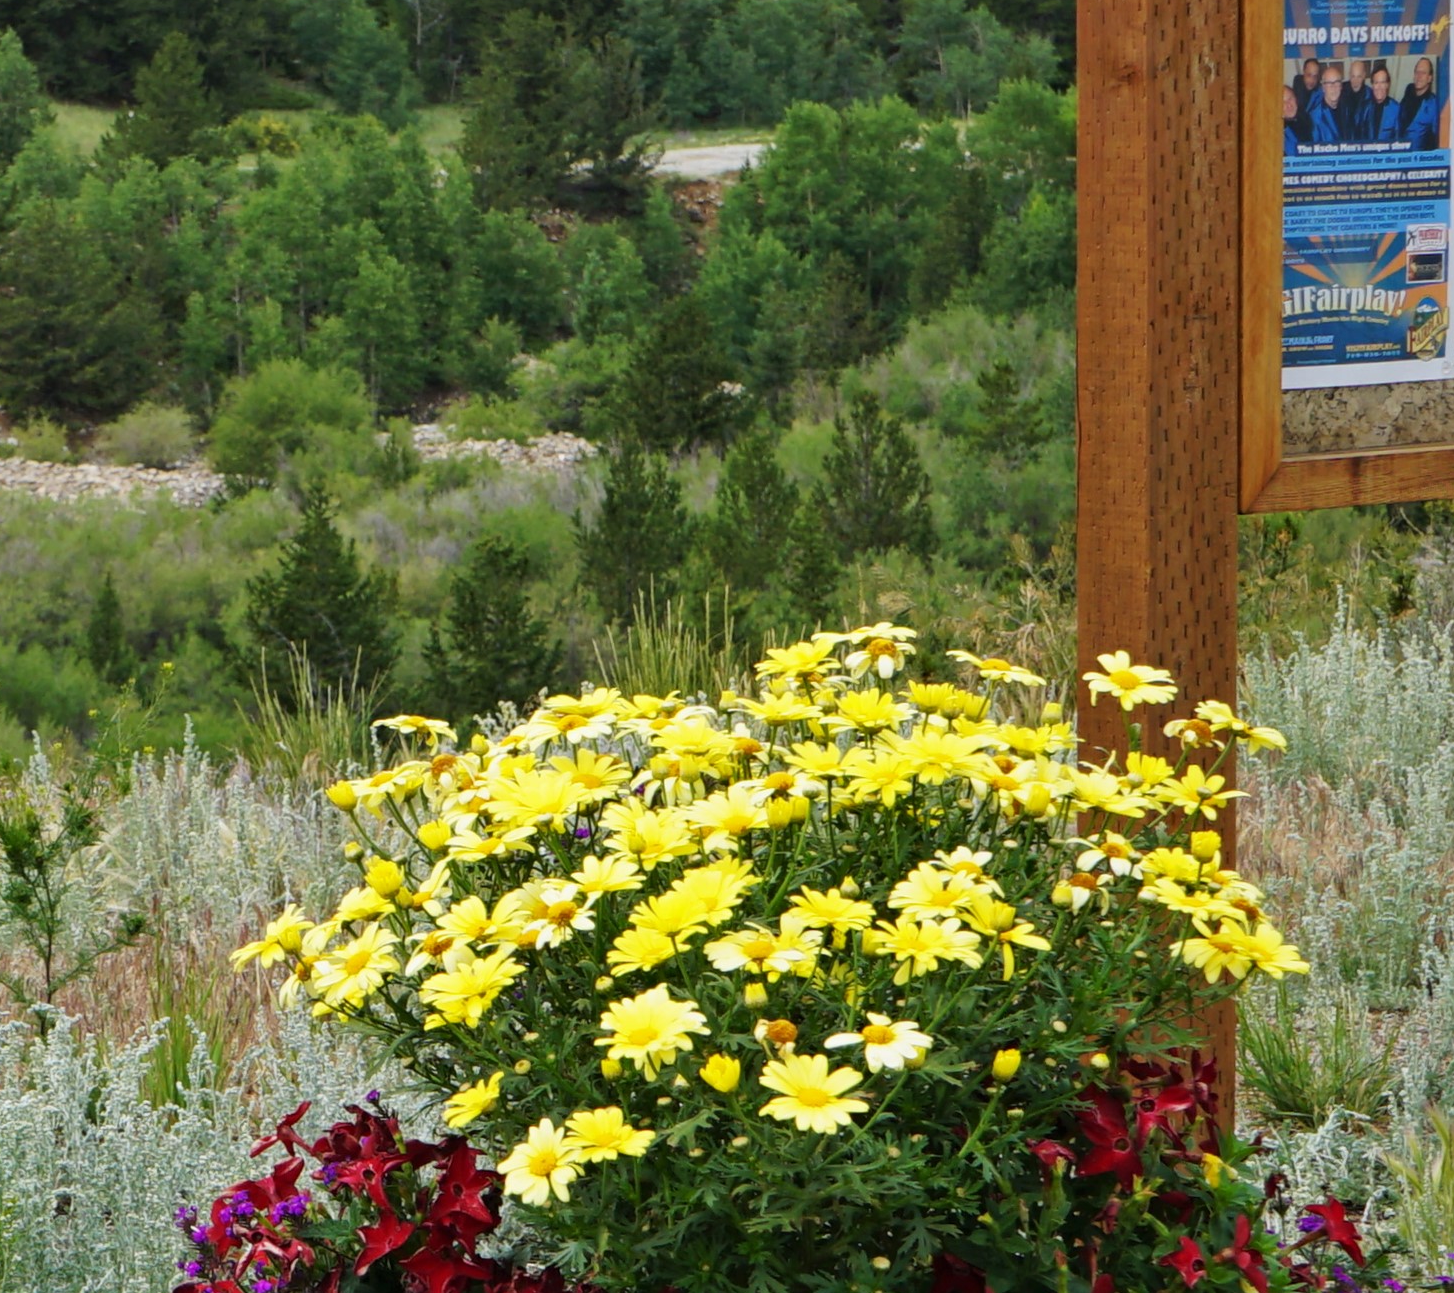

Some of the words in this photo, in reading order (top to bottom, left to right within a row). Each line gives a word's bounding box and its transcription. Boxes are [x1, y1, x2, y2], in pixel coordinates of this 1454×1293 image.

[1330, 27, 1368, 44] DAYS
[1370, 25, 1430, 43] KICKOFF!
[1297, 145, 1312, 154] The
